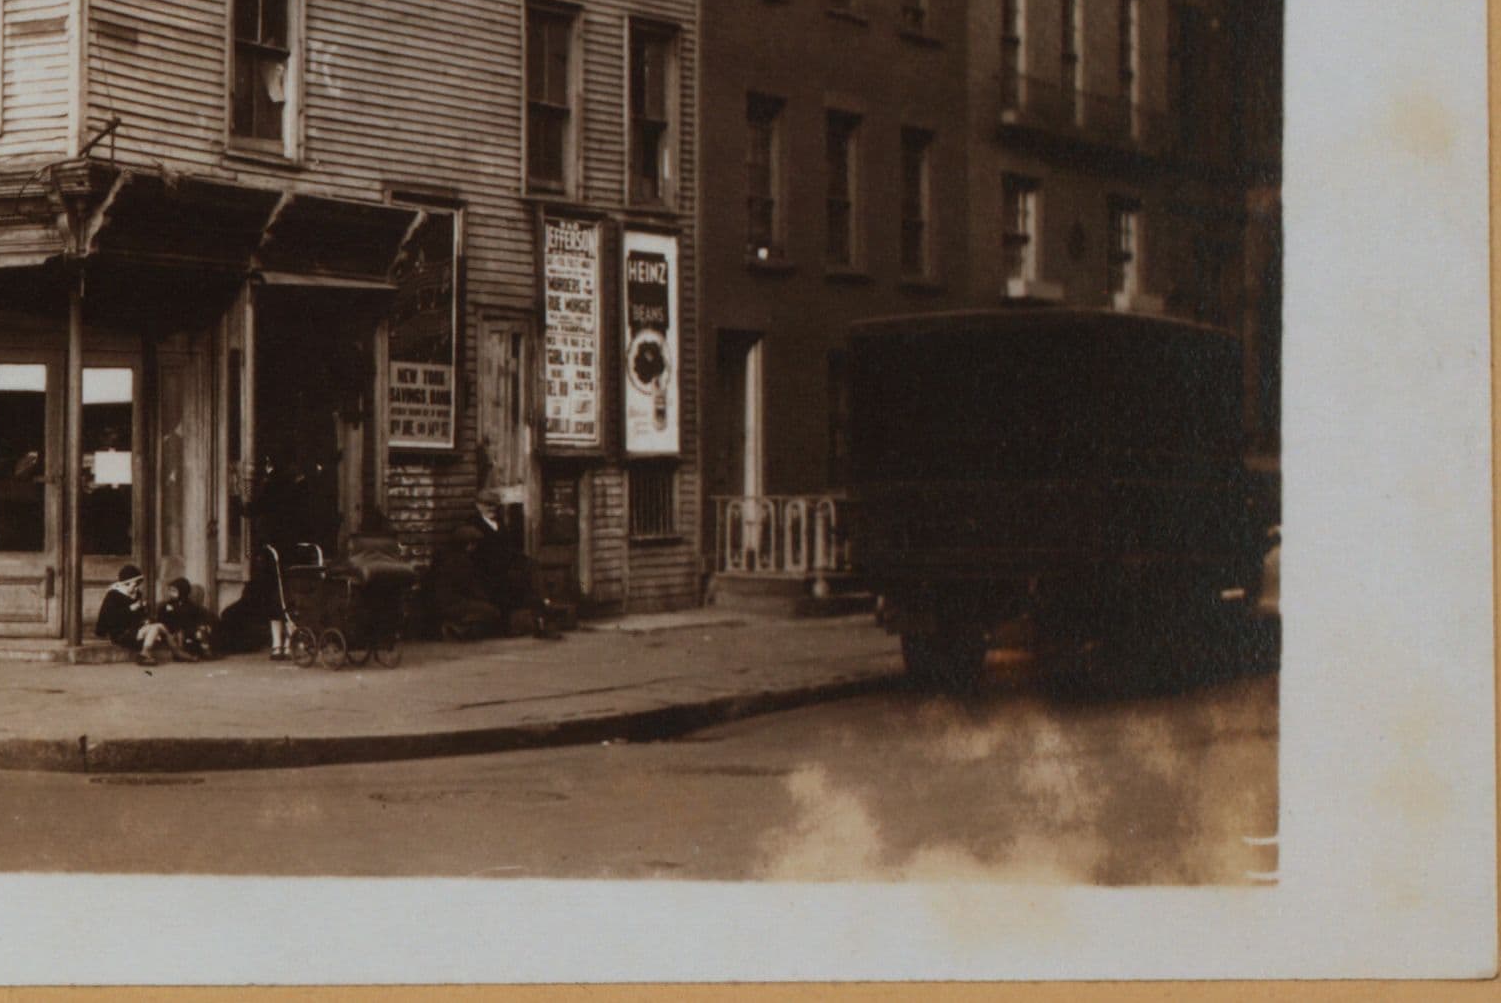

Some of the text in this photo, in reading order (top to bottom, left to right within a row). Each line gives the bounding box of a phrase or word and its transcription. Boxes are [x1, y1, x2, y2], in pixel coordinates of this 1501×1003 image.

[545, 225, 596, 258] JEFFERSON
[628, 259, 667, 285] HEINZ
[633, 304, 664, 322] BEANS
[397, 368, 445, 387] NEW YORK
[390, 387, 452, 406] SAVINGS BANK
